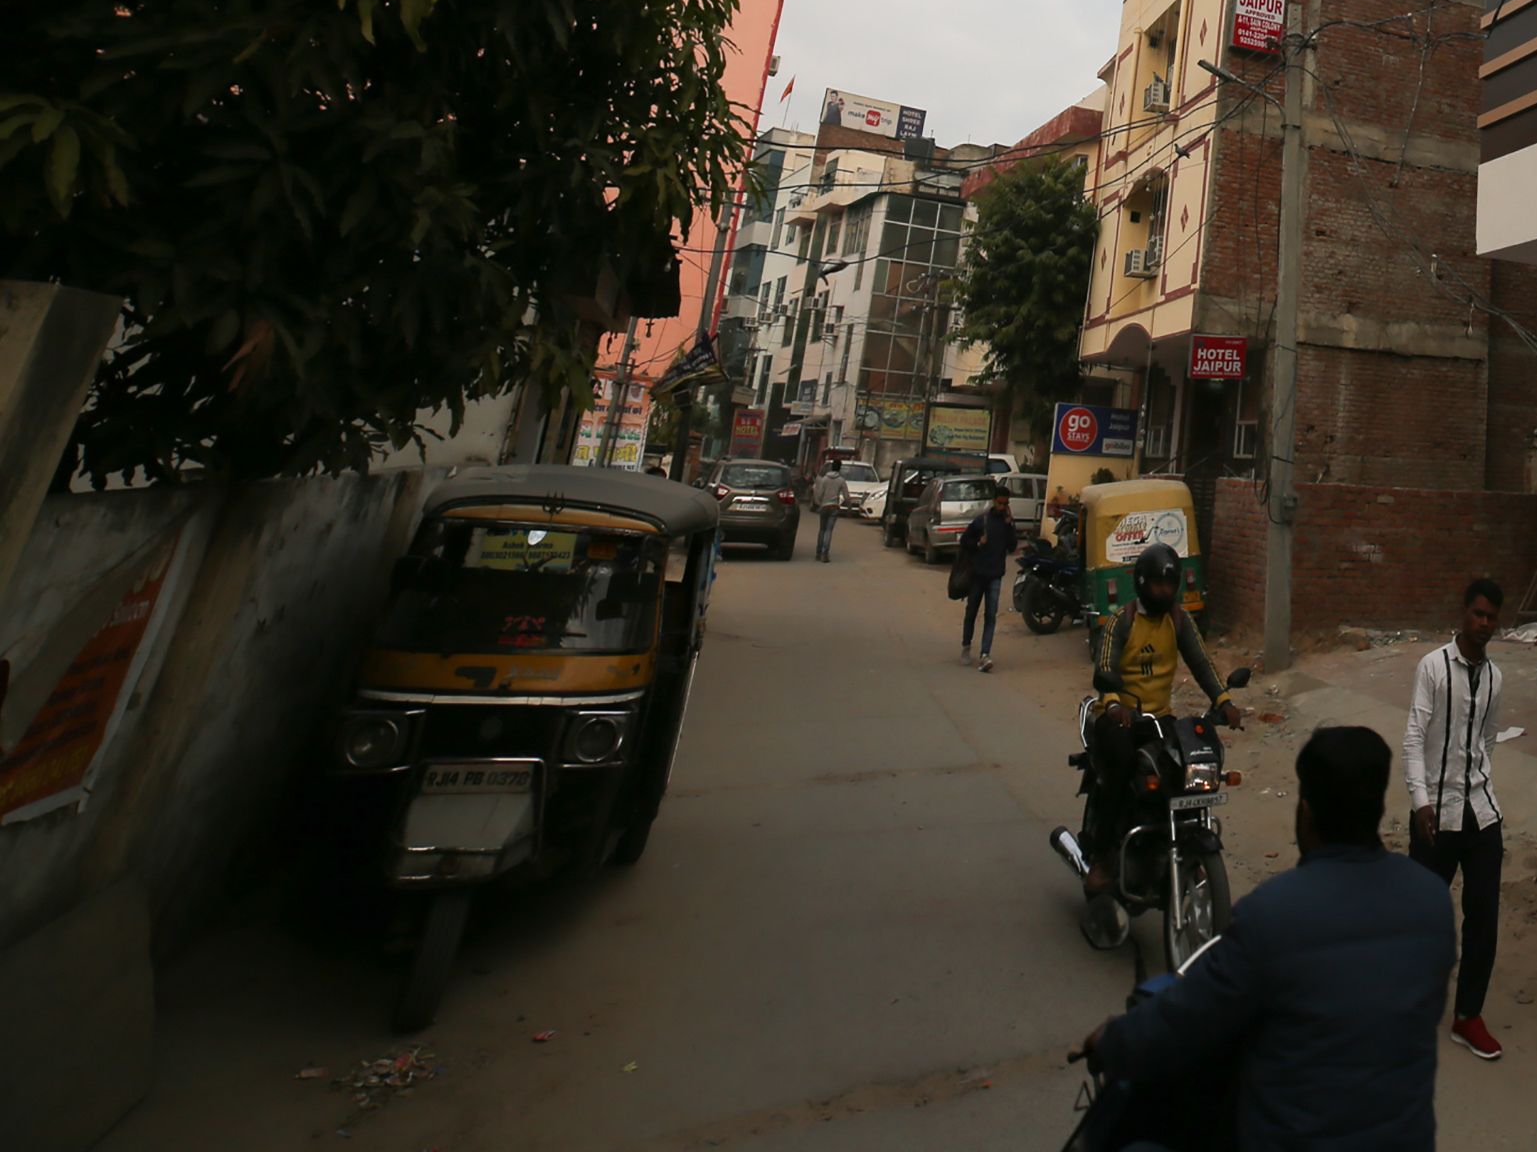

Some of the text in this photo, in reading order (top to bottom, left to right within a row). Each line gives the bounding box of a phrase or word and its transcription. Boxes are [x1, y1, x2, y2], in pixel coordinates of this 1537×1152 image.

[1244, 9, 1276, 20] APPROVED
[1261, 20, 1281, 32] COLONY
[903, 109, 922, 119] HOTEL
[1197, 347, 1241, 361] HOTEL
[1193, 360, 1242, 373] JAIPUR
[1067, 414, 1091, 432] go
[1066, 431, 1090, 443] STAYS
